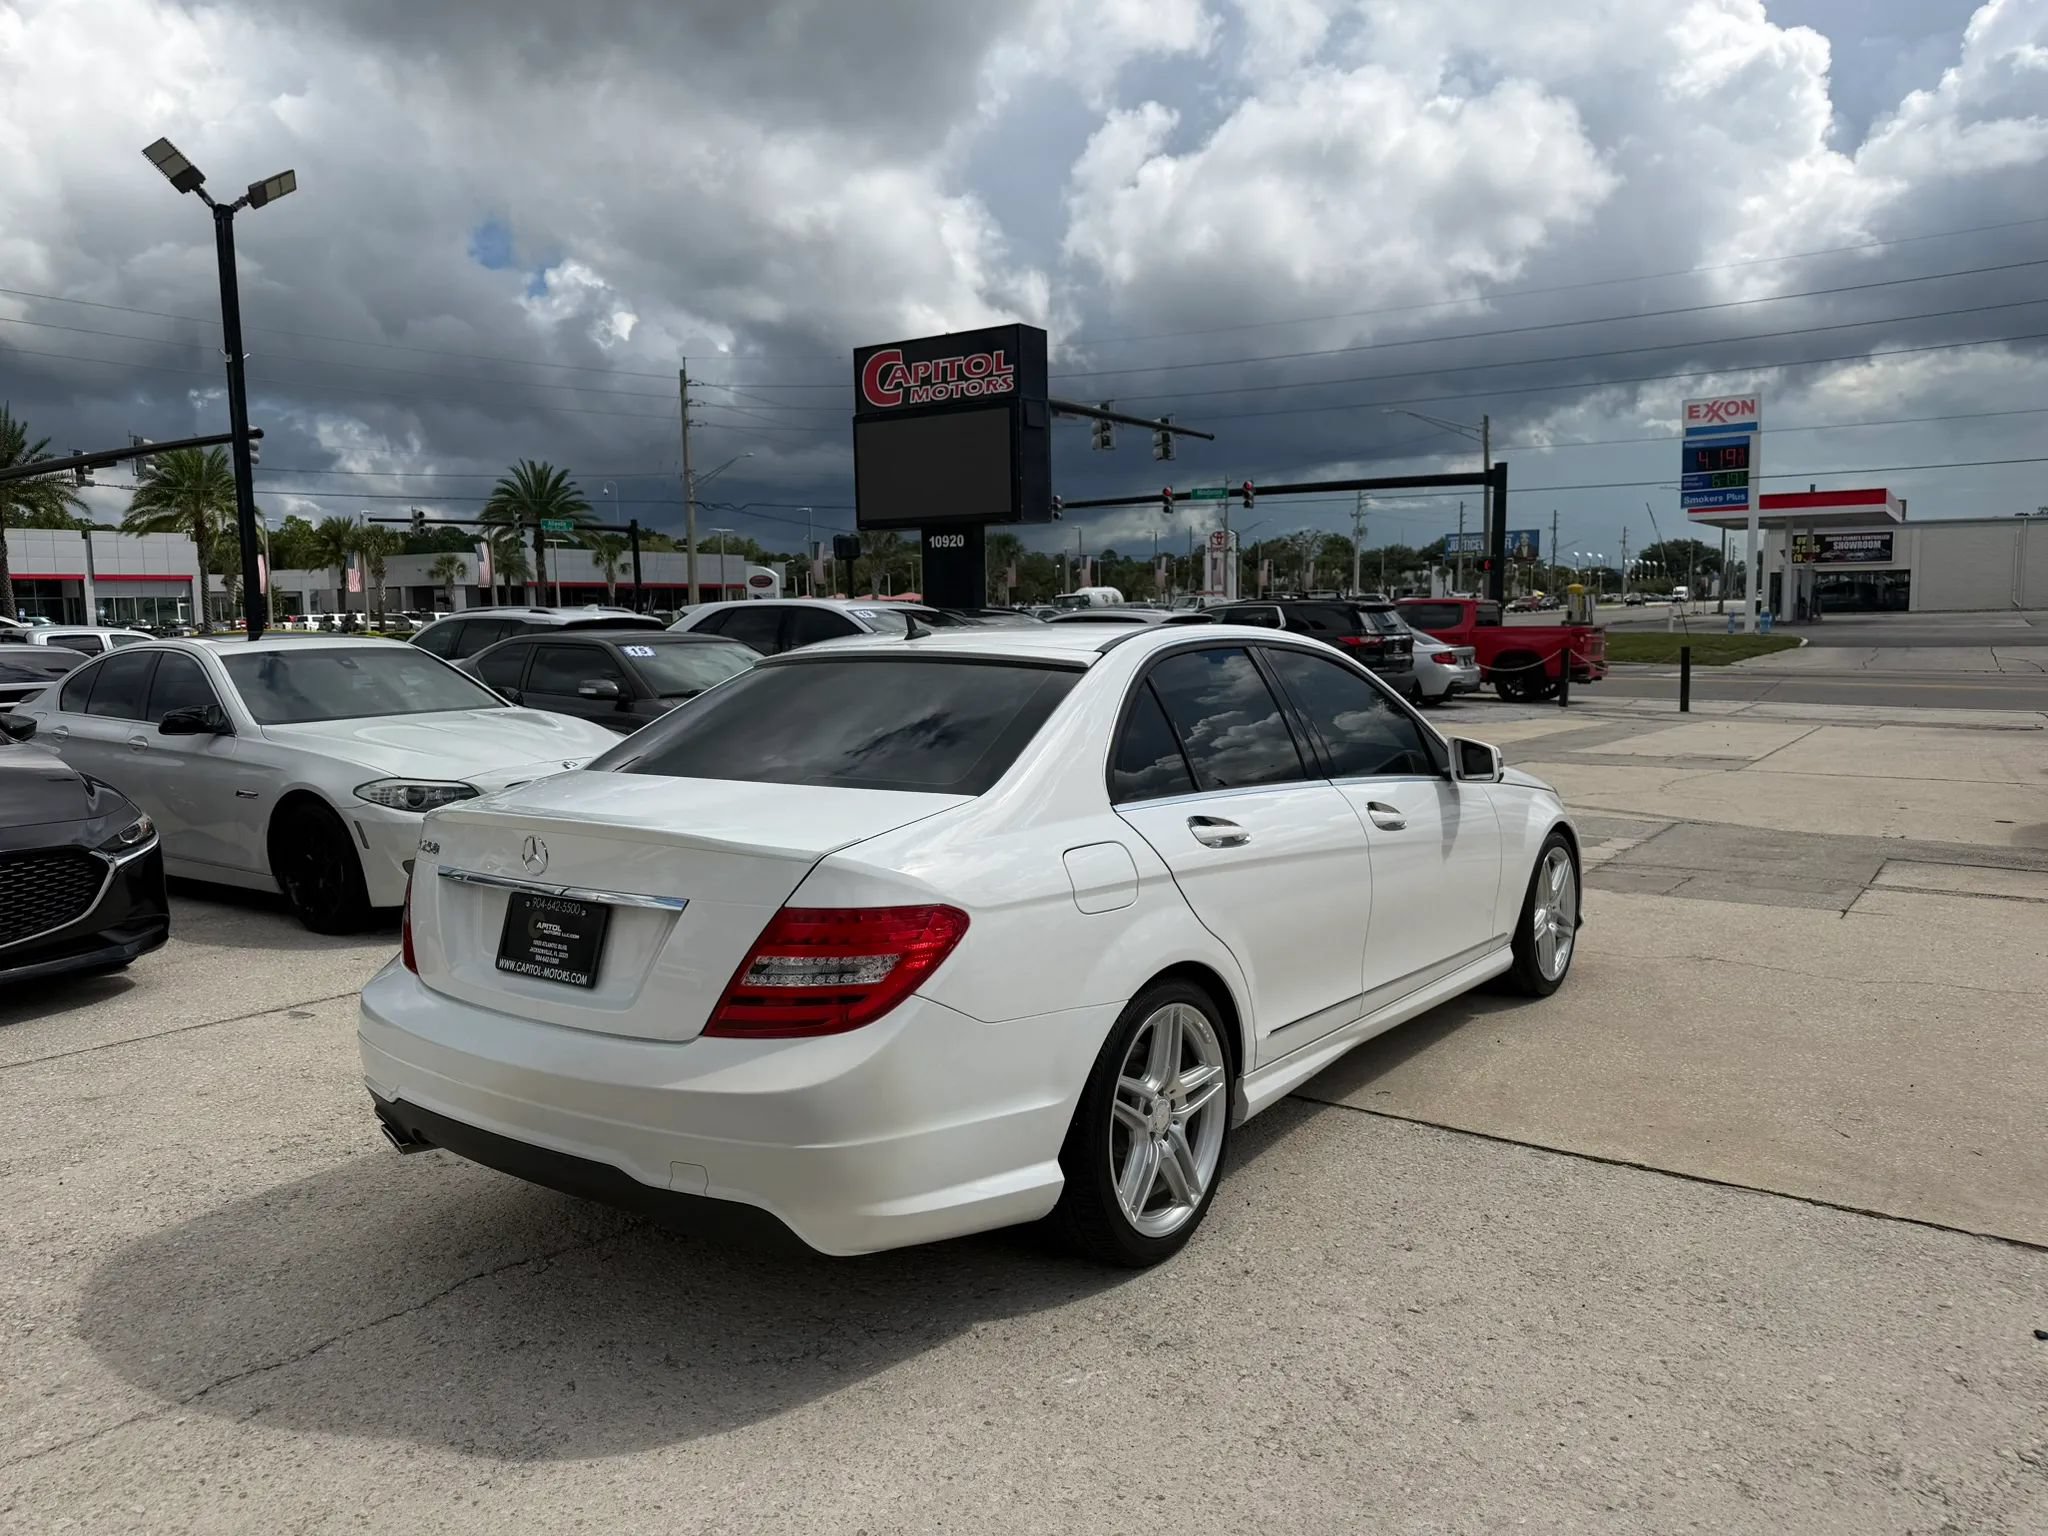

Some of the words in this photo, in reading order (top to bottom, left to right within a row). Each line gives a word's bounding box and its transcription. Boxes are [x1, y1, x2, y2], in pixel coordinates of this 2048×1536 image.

[862, 349, 1014, 407] CAPITOL
[910, 374, 1014, 404] MOTORS
[1688, 400, 1755, 423] EXXON
[1684, 495, 1723, 505] Smokers
[1726, 491, 1746, 502] Plus
[929, 535, 964, 548] 10920
[1833, 540, 1881, 550] SHOWROOM
[532, 898, 581, 915] 904-642-5500
[499, 958, 588, 985] WWW.CAPITOL-MOTORS.COM
